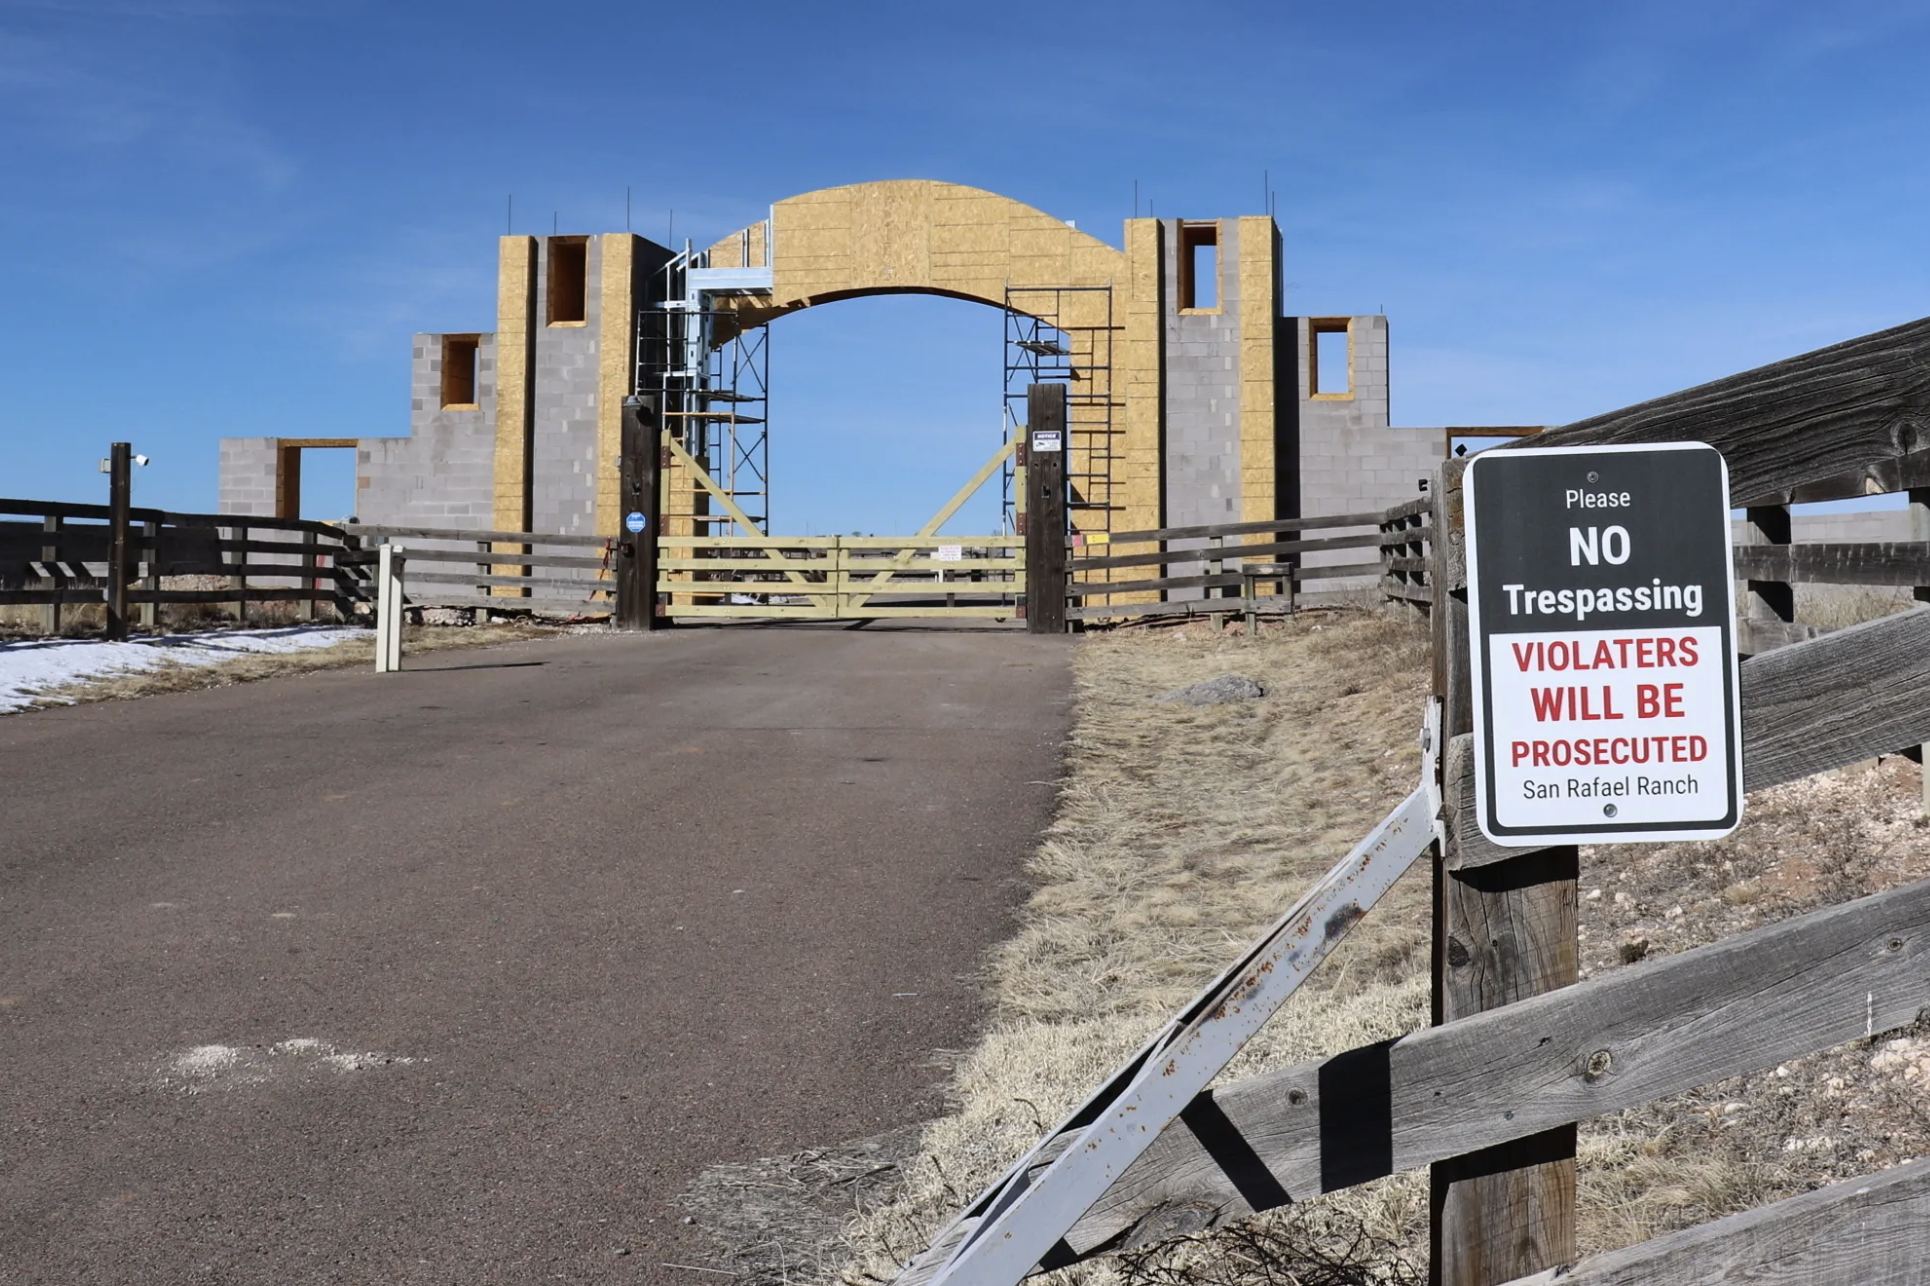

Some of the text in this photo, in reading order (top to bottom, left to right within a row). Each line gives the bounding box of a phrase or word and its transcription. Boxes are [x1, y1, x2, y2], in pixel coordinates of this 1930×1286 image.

[1566, 489, 1631, 509] Please
[1569, 525, 1631, 566] NO
[1502, 578, 1703, 621] Trespassing
[1512, 636, 1699, 672] VIOLATERS
[1530, 683, 1685, 722] WILL BE
[1511, 735, 1707, 767] PROSECUTED
[1523, 773, 1699, 799] San Rafael Ranch
